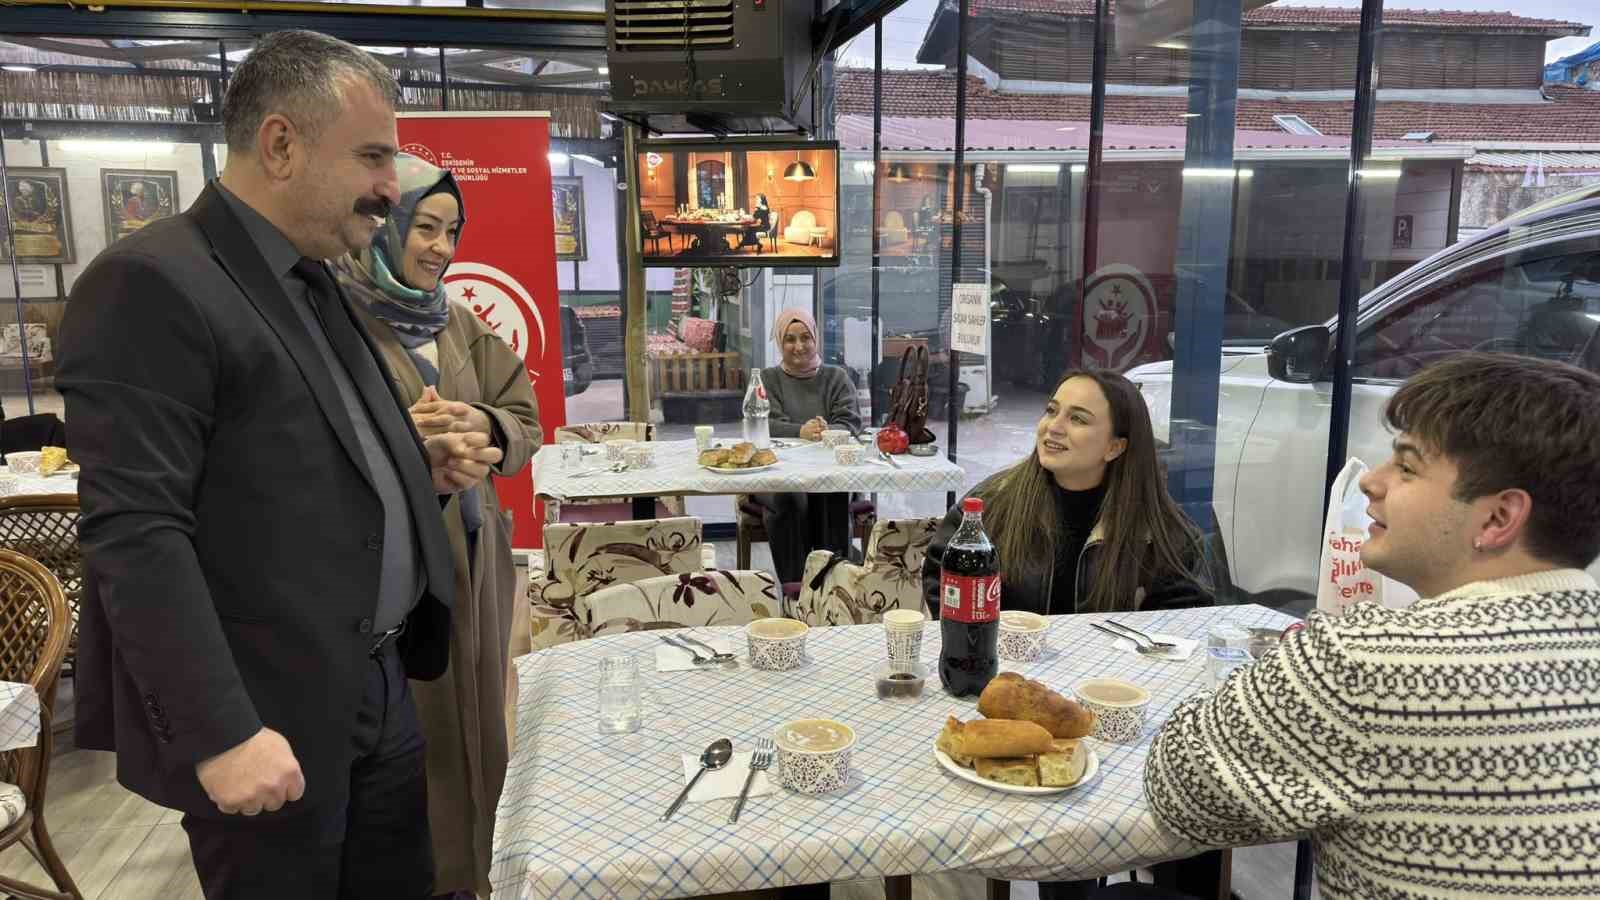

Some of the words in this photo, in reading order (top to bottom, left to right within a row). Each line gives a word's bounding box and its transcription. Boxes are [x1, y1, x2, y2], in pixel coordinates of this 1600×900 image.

[1398, 219, 1408, 237] P
[1328, 537, 1361, 552] aha
[1338, 582, 1373, 598] evre
